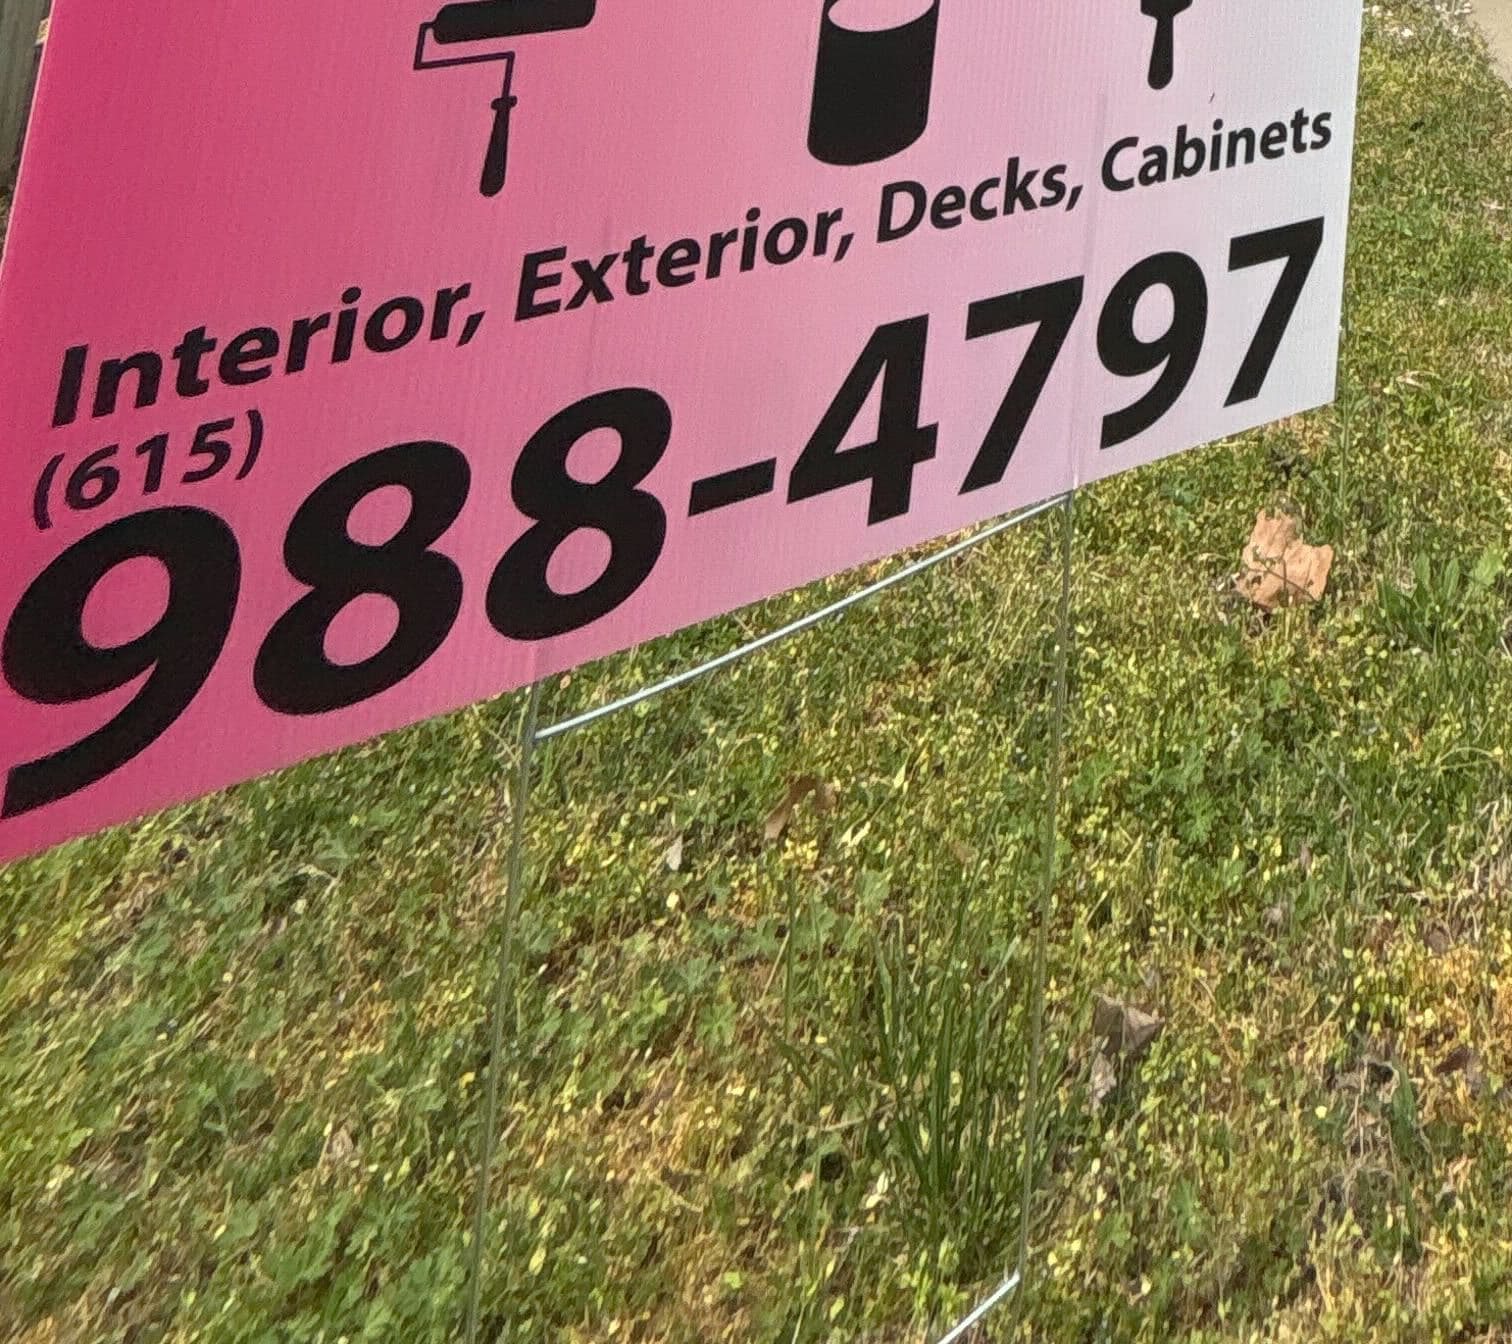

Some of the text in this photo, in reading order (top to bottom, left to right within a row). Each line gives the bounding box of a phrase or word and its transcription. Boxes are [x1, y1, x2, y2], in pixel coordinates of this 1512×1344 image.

[51, 108, 1332, 429] Interior, Exterior, Decks, Cabinets
[0, 216, 1325, 820] 988-4797
[33, 409, 264, 531] (615)
